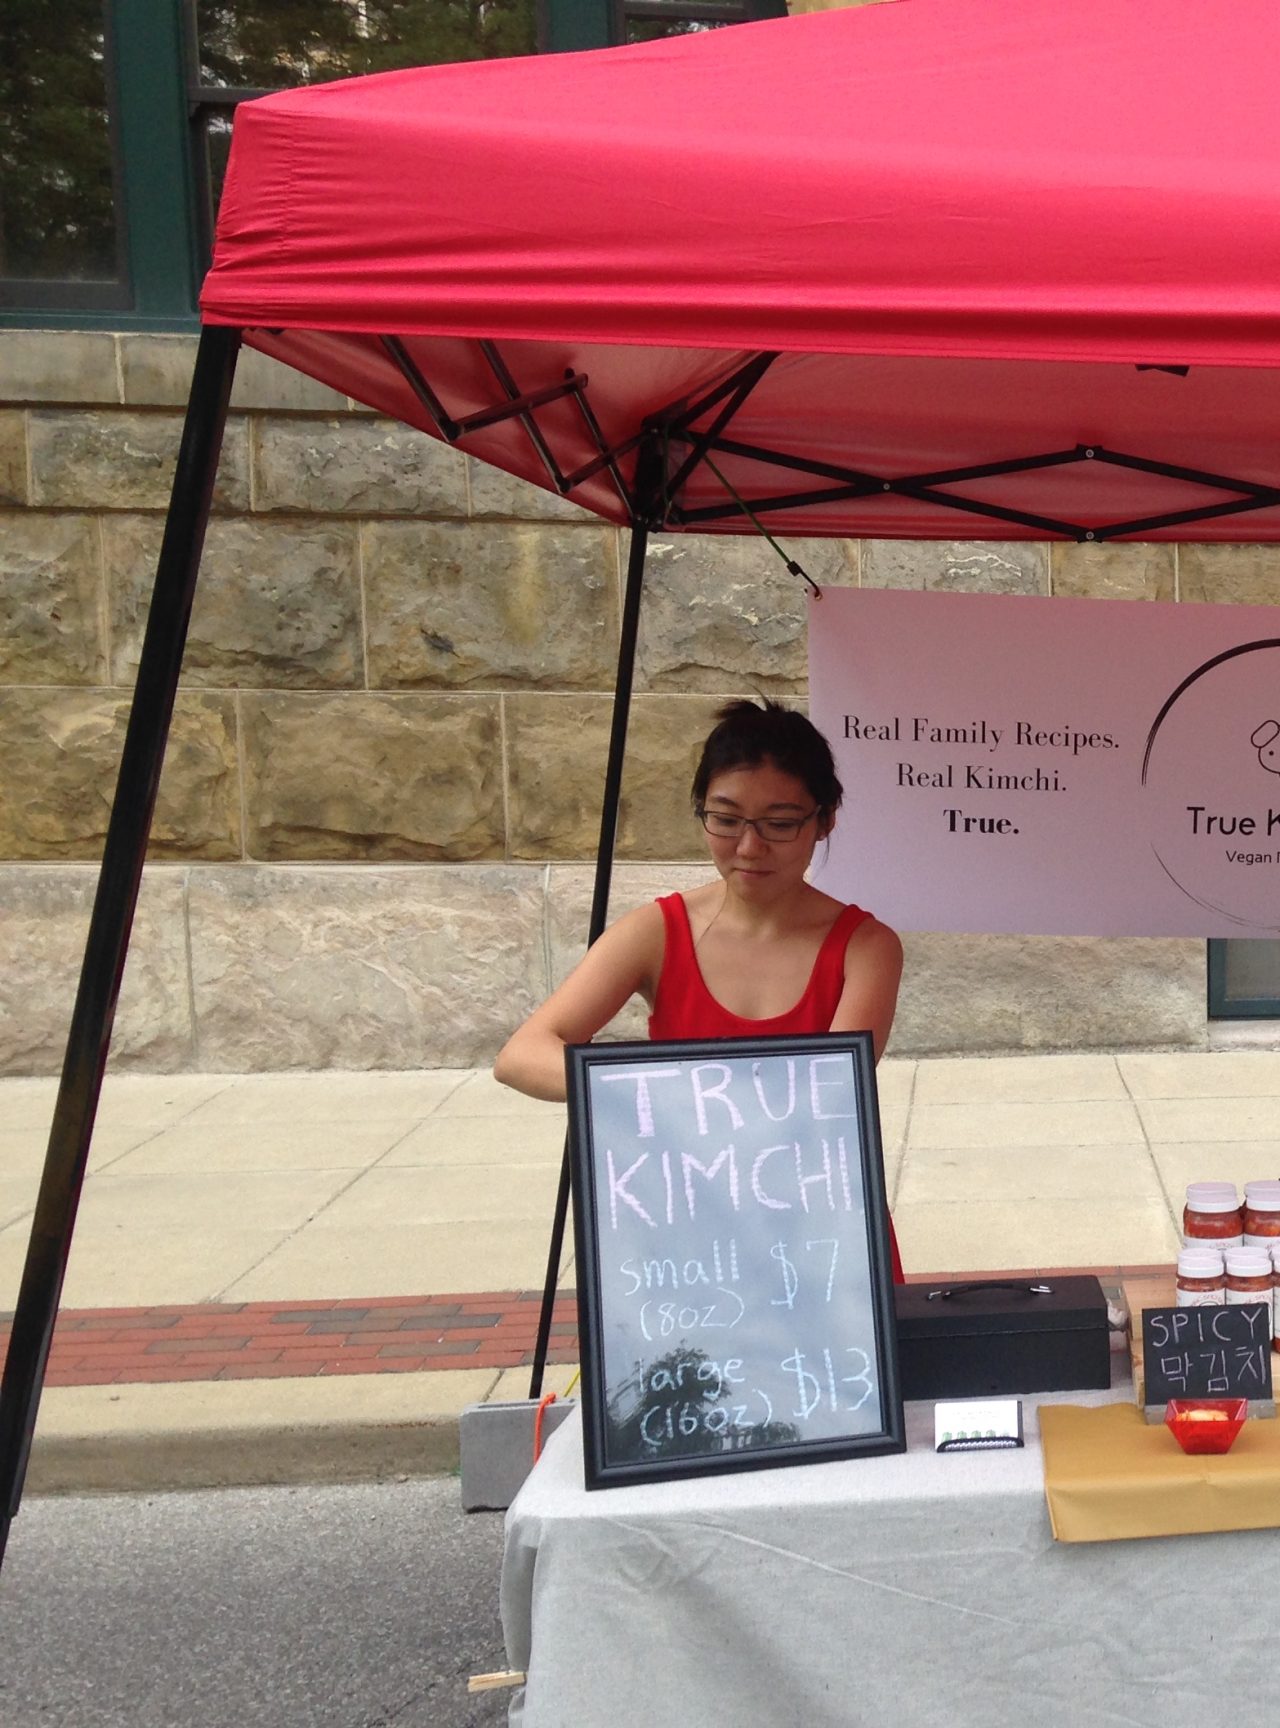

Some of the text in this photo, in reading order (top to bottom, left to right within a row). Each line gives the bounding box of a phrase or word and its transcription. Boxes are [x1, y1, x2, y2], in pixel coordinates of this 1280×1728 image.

[843, 715, 1120, 756] Real Family Recipes.
[896, 763, 1067, 791] Real Kimchi.
[943, 809, 1020, 835] True.
[1187, 806, 1256, 835] True
[1225, 850, 1272, 866] Vegan
[601, 1057, 856, 1137] TRUE
[606, 1137, 852, 1229] KIMCHI
[620, 1239, 839, 1309] small $7
[1150, 1307, 1262, 1347] SPICY
[637, 1348, 873, 1420] large $13
[1161, 1345, 1266, 1392] 막김치
